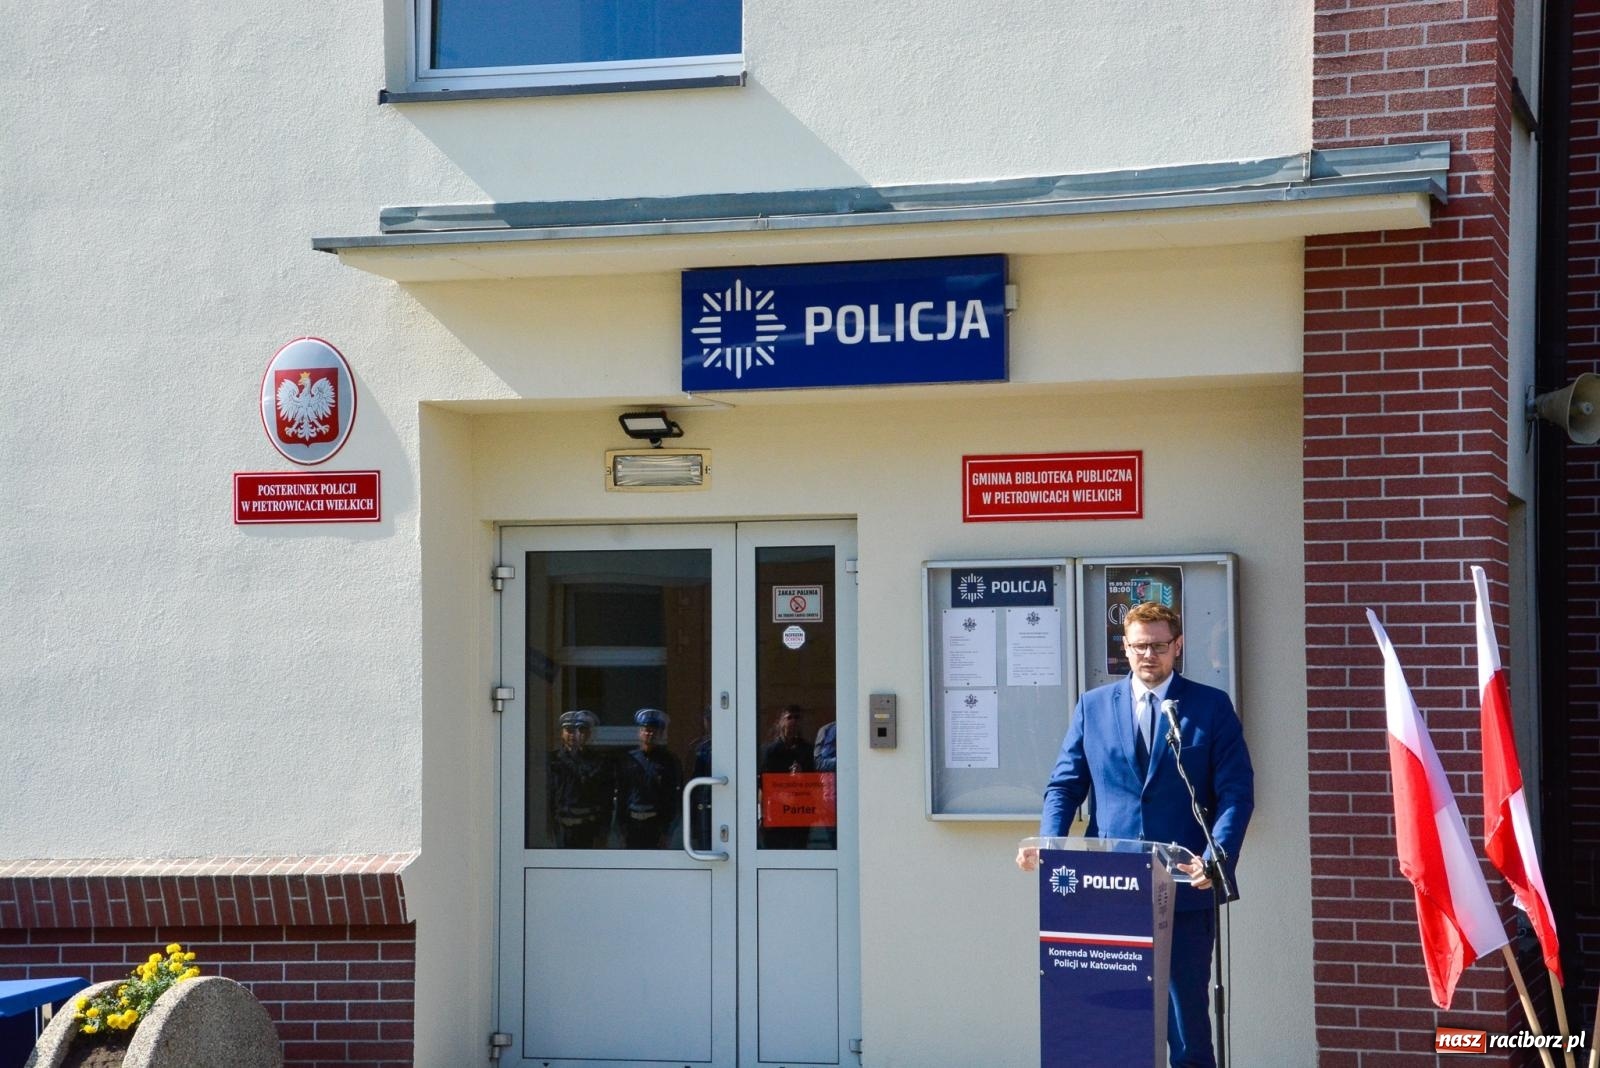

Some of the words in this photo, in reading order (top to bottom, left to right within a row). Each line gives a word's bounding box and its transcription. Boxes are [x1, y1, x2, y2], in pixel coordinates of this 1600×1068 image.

[804, 299, 991, 345] POLICJA
[972, 472, 1012, 486] GMINNA
[1015, 471, 1073, 485] BIBLIOTEKA
[1076, 469, 1133, 483] PUBLICZNA
[258, 484, 318, 496] POSTERUNEK
[320, 483, 357, 495] POLICJI
[982, 492, 991, 505] W
[994, 490, 1069, 504] PIETROWICACH
[1072, 489, 1122, 503] WIELKICH
[241, 501, 250, 512] W
[252, 500, 324, 512] PIETROWICACH
[325, 499, 373, 511] WIELKICH
[991, 580, 1047, 593] POLICJA
[783, 804, 816, 814] Parter
[1083, 875, 1140, 891] POLICJA
[1048, 947, 1088, 958] Komenda
[1089, 949, 1143, 961] Wojewódzka
[1054, 959, 1079, 970] Policji
[1089, 960, 1137, 972] Katowicach
